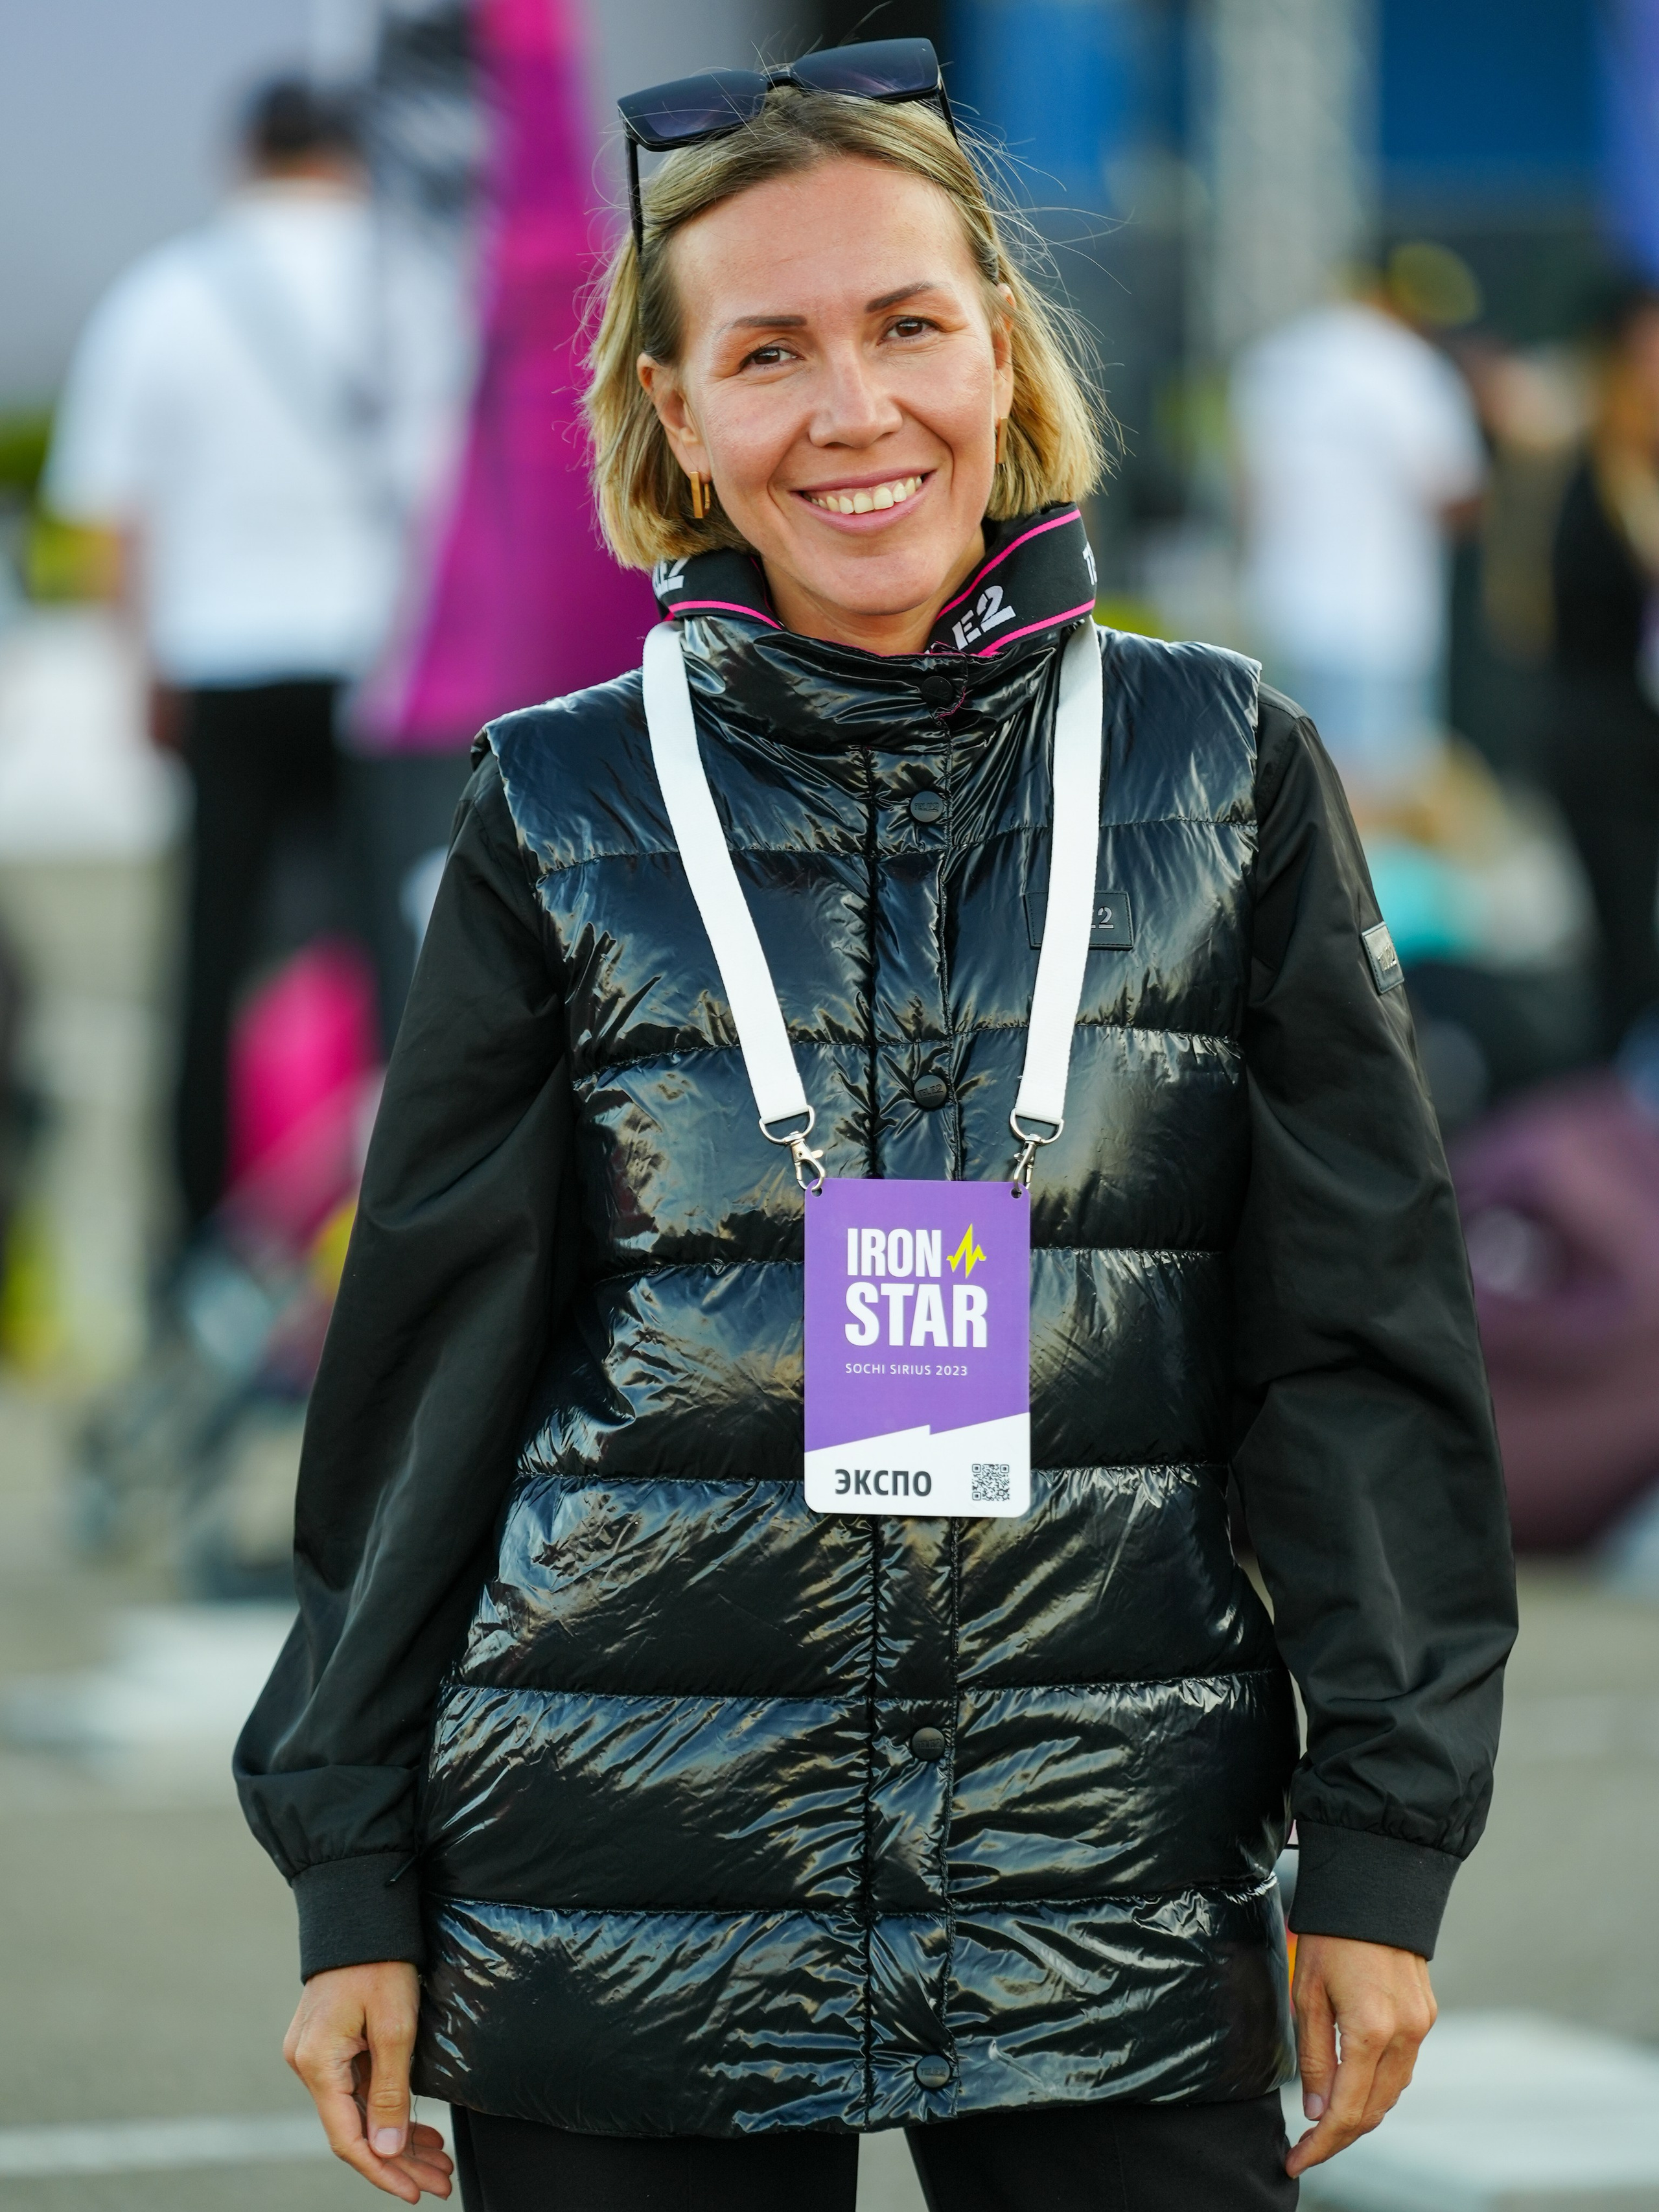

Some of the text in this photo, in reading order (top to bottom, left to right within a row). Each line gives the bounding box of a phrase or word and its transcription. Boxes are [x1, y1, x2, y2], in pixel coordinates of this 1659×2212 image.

[918, 1084, 944, 1098] TELE2
[847, 1228, 942, 1277] IRON
[844, 1282, 988, 1347] STAR
[845, 1363, 968, 1376] SOCHI SIRIUS 2023
[835, 1469, 932, 1496] ЭКСПО
